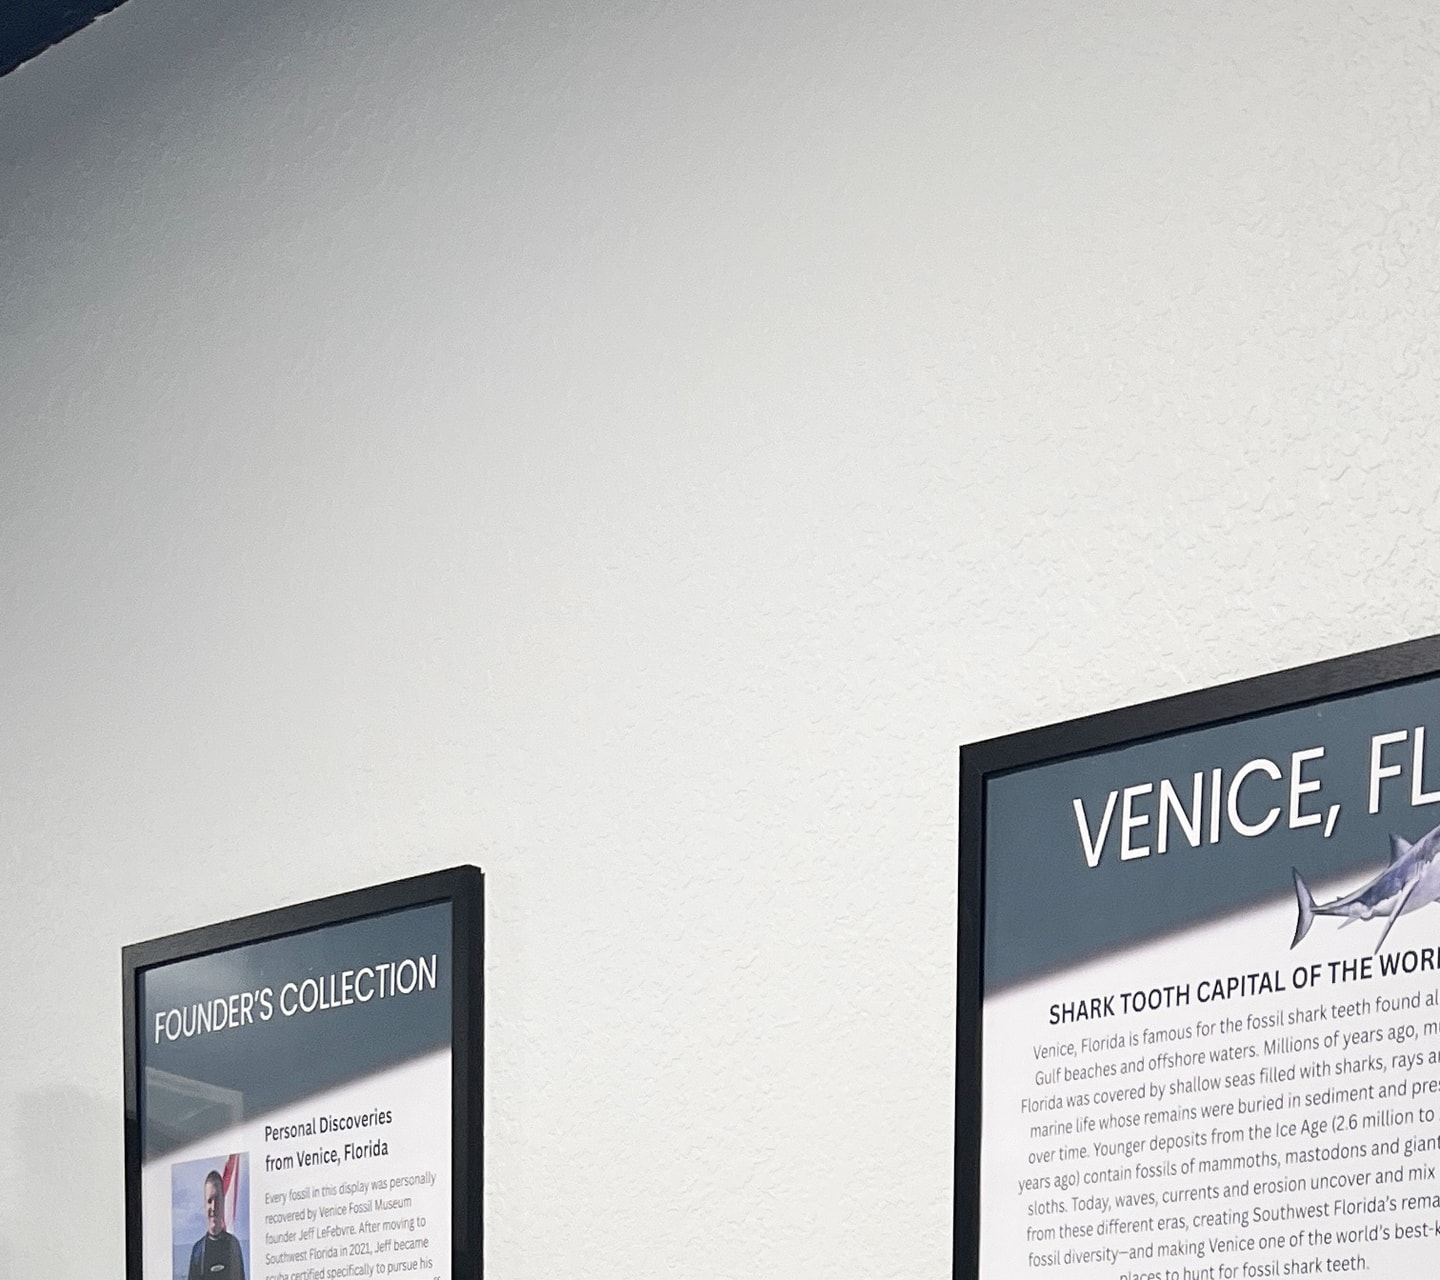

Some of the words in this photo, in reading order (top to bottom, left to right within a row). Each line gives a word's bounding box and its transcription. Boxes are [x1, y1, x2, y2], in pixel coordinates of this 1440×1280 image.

[1072, 746, 1341, 867] VENICE,
[154, 987, 273, 1044] FOUNDER'S
[279, 953, 437, 1016] COLLECTION
[1048, 994, 1115, 1025] SHARK
[1119, 983, 1189, 1014] TOOTH
[1196, 969, 1286, 1003] CAPITAL
[1292, 963, 1322, 989] OF
[1327, 955, 1372, 984] THE
[1032, 1042, 1077, 1060] Venice,
[1081, 1032, 1125, 1052] Florida
[1128, 1033, 1139, 1046] is
[1142, 1025, 1192, 1044] famous
[1195, 1020, 1216, 1037] for
[1219, 1016, 1243, 1034] the
[1246, 1009, 1284, 1030] fossil
[1287, 1003, 1327, 1025] shark
[1330, 998, 1371, 1019] teeth
[1375, 990, 1421, 1012] found
[1034, 1066, 1061, 1086] Gulf
[1063, 1062, 1116, 1082] beaches
[1119, 1056, 1144, 1074] and
[1147, 1051, 1206, 1071] offshore
[1208, 1044, 1260, 1062] waters.
[1263, 1036, 1320, 1055] Millions
[1323, 1029, 1340, 1048] of
[1341, 1028, 1383, 1051] years
[1387, 1024, 1418, 1044] ago,
[264, 1117, 316, 1142] Personal
[319, 1107, 392, 1134] Discoveries
[264, 1154, 293, 1172] from
[295, 1146, 340, 1167] Venice,
[343, 1138, 388, 1161] Florida
[264, 1191, 287, 1206] Every
[288, 1186, 310, 1201] fossil
[311, 1187, 320, 1198] in
[320, 1185, 337, 1197] this
[338, 1180, 369, 1196] display
[370, 1178, 388, 1190] was
[389, 1170, 436, 1191] personally
